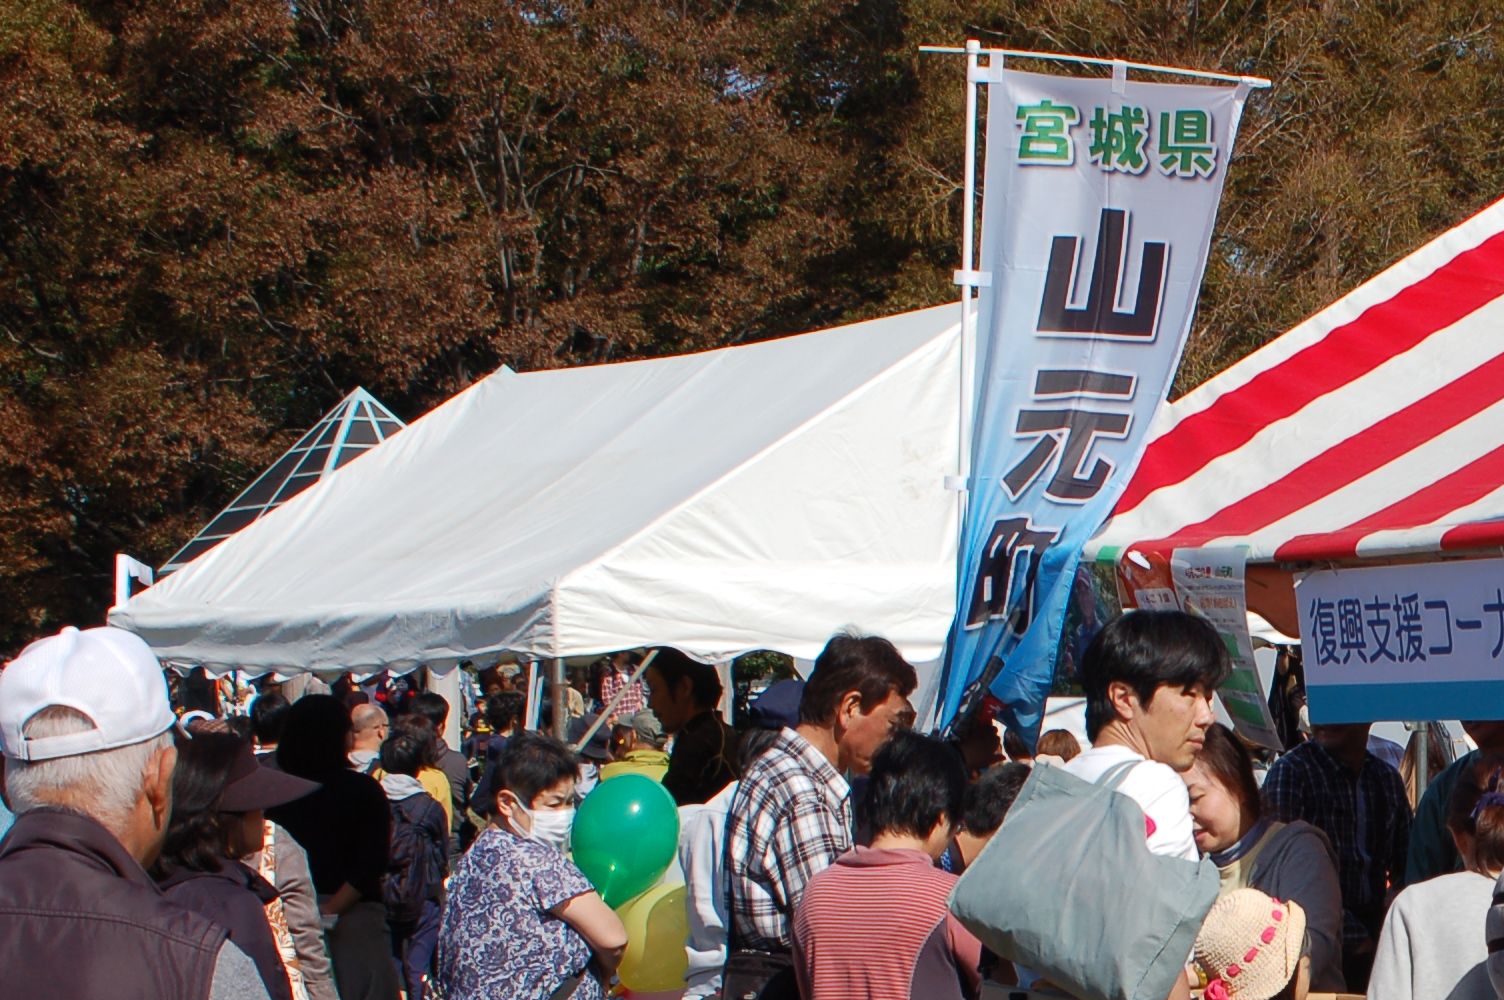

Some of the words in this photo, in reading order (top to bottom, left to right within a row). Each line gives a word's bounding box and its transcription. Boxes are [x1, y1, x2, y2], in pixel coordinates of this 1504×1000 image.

[1015, 100, 1217, 179] 宮城県
[964, 207, 1172, 640] 山元町
